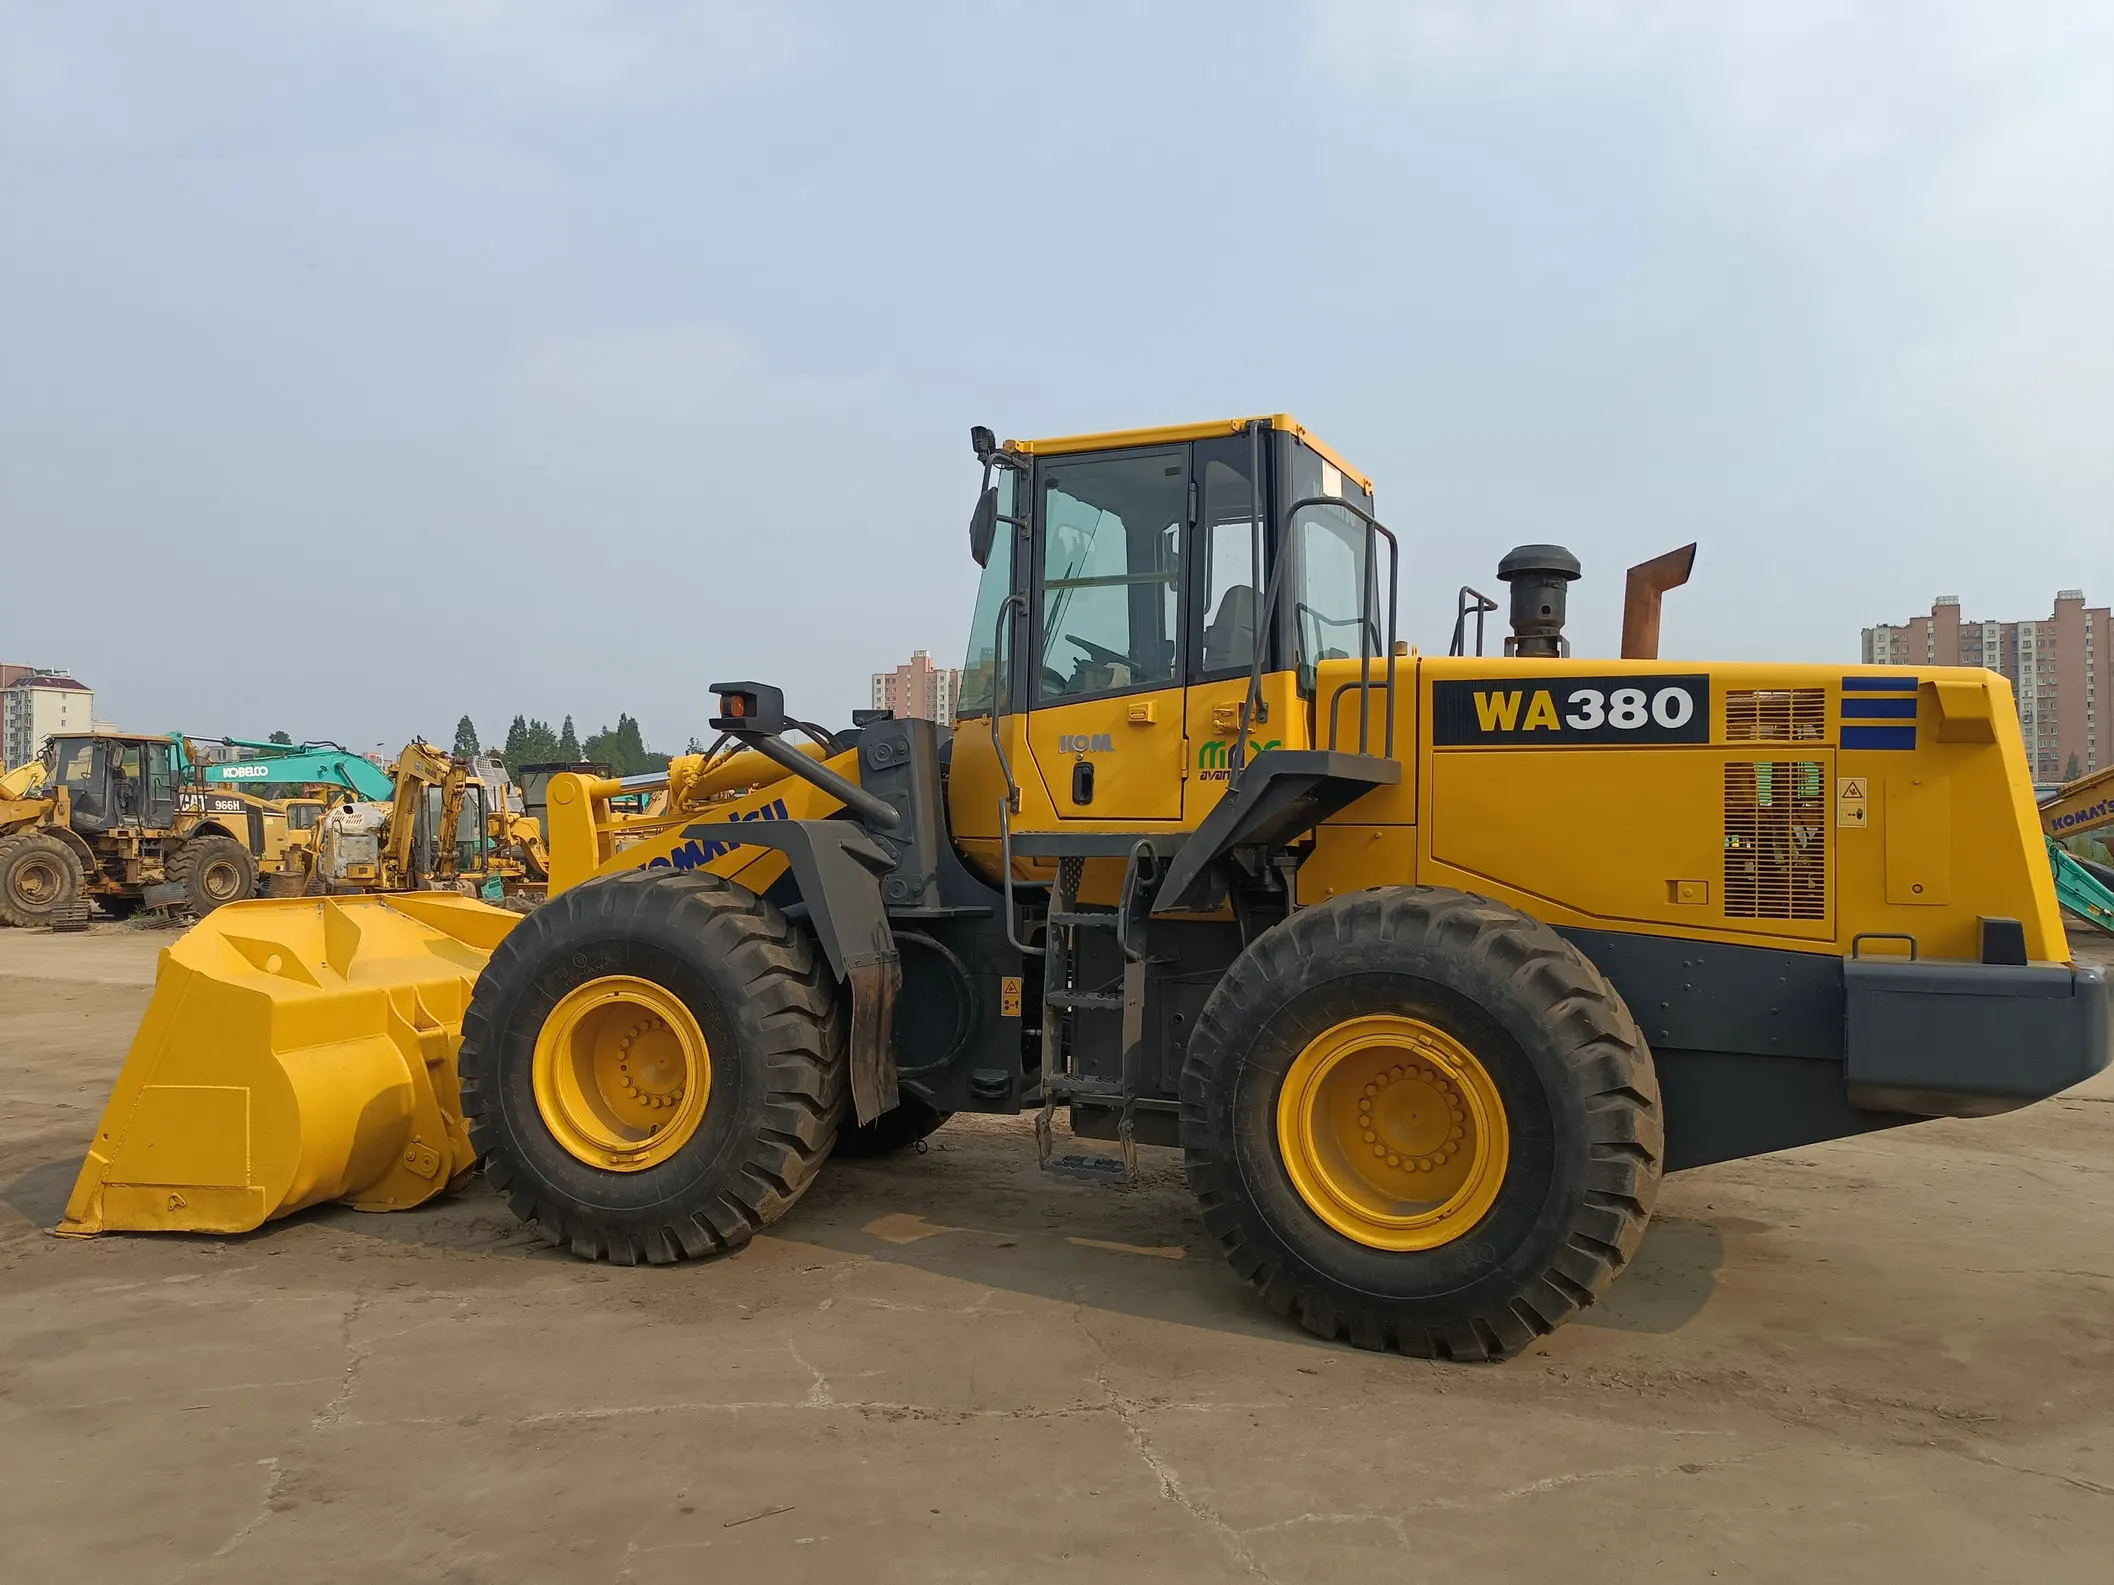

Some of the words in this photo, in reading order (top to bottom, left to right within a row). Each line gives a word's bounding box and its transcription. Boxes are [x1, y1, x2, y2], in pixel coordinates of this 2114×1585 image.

[1473, 686, 1694, 732] WA380
[1059, 733, 1115, 753] KOM
[222, 766, 269, 778] KOBELCO
[180, 794, 208, 812] CAT
[215, 800, 240, 811] 966H
